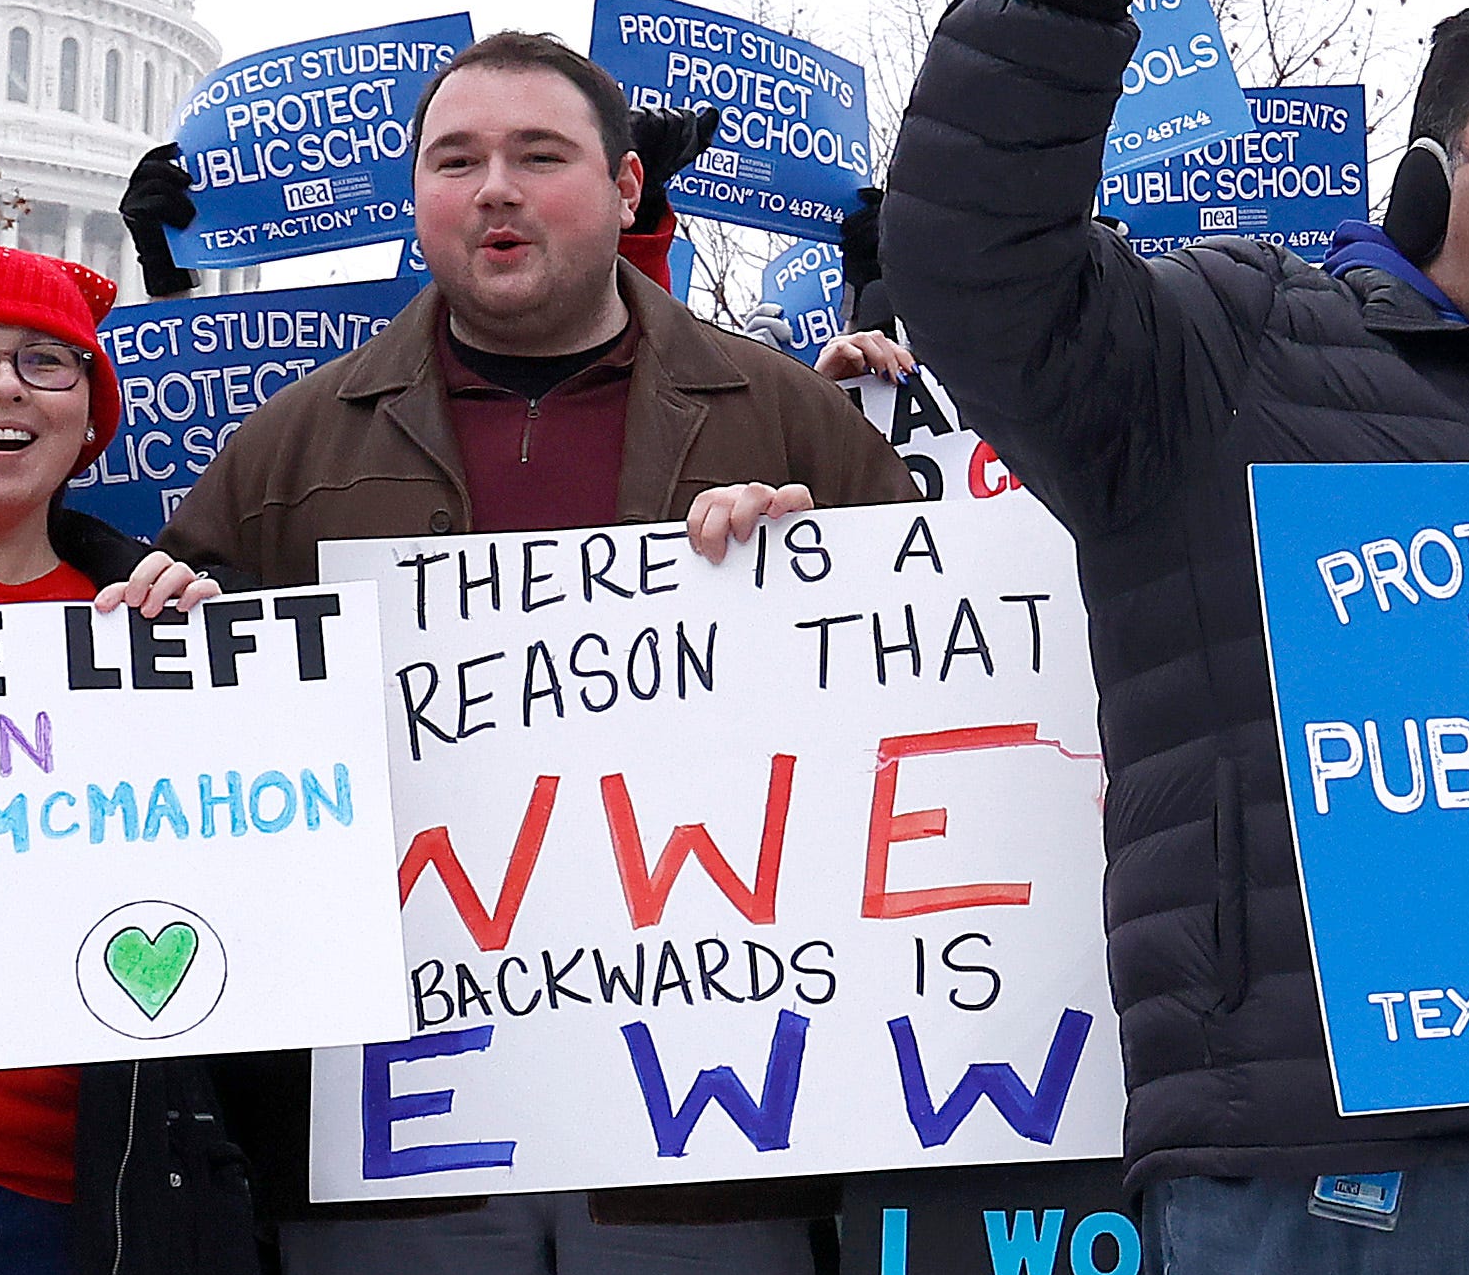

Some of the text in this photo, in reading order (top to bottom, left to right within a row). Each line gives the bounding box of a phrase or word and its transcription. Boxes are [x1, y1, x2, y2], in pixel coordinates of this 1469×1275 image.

[180, 43, 455, 126] PROTECT STUDENTS
[619, 15, 737, 55] PROTECT
[741, 32, 853, 108] STUDENTS
[667, 51, 812, 120] PROTECT
[226, 79, 395, 142] PROTECT
[719, 106, 869, 176] SCHOOLS
[1110, 110, 1212, 154] TO 48744
[1245, 98, 1348, 133] TUDENTS
[179, 138, 294, 193] UBLIC
[298, 119, 413, 172] SCHO
[1102, 164, 1361, 206] PUBLIC SCHOOLS
[200, 224, 257, 250] TEXT
[262, 205, 358, 241] "ACTION"
[364, 202, 397, 221] TO
[288, 183, 330, 207] nea
[759, 190, 785, 212] TO
[789, 199, 845, 224] 48744
[1203, 209, 1234, 228] nea
[1130, 238, 1174, 255] TEXT
[122, 359, 316, 426] ROTECT
[398, 516, 943, 631] THERE IS A
[67, 592, 340, 690] LEFT
[397, 593, 1053, 761] REASON THAT
[410, 933, 1001, 1030] BACKWARDS IS
